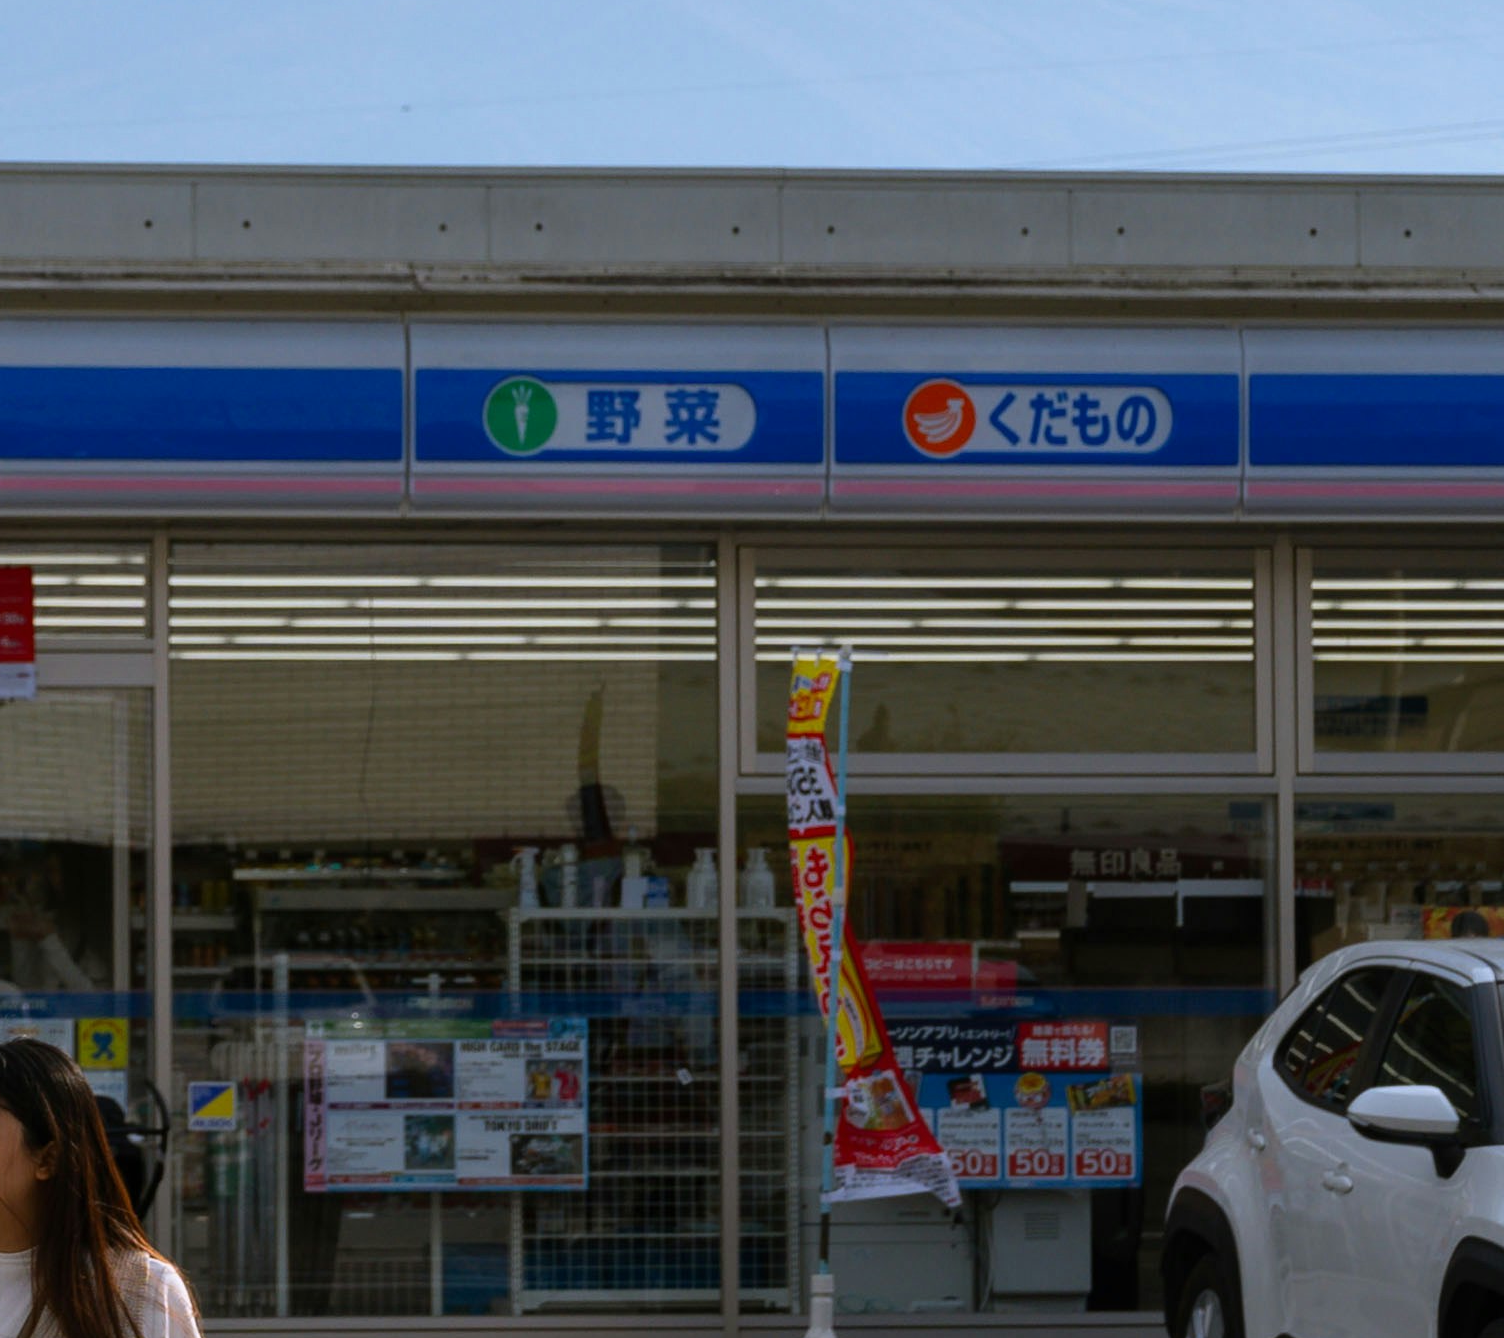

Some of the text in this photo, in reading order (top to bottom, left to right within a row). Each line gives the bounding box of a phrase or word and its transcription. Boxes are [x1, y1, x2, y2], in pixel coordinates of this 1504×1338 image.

[585, 389, 720, 445] 野菜
[988, 395, 1157, 445] くだもの
[1070, 848, 1182, 877] 無印良品
